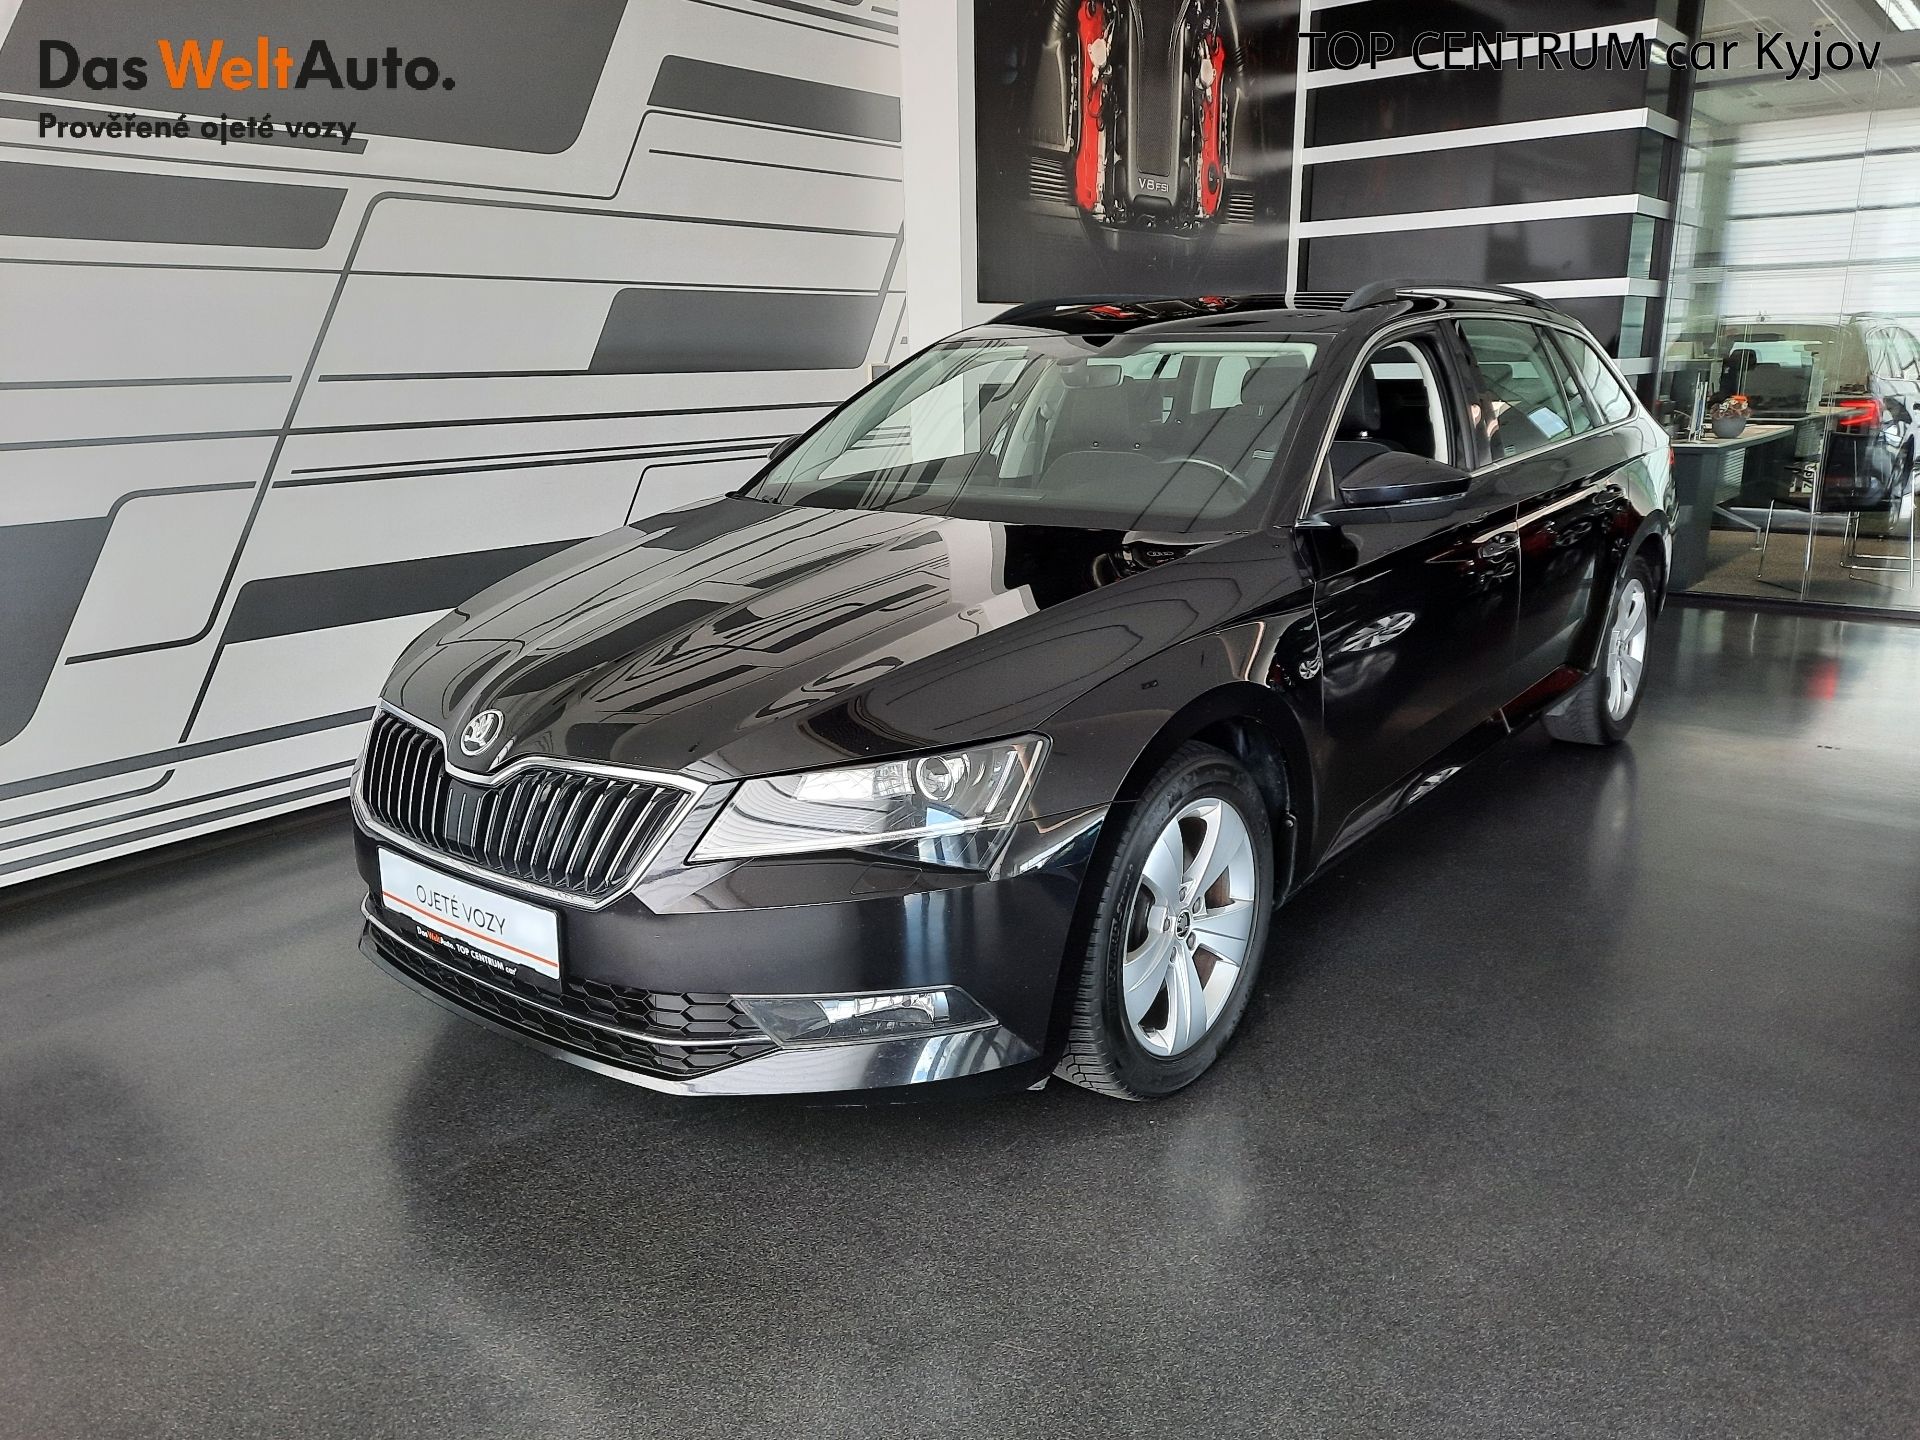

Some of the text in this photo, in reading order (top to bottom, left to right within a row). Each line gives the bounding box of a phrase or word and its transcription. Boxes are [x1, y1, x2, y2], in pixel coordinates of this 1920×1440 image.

[416, 884, 506, 935] OJETÉ VOZY
[455, 943, 470, 956] TOP
[470, 950, 505, 971] CENTRUM
